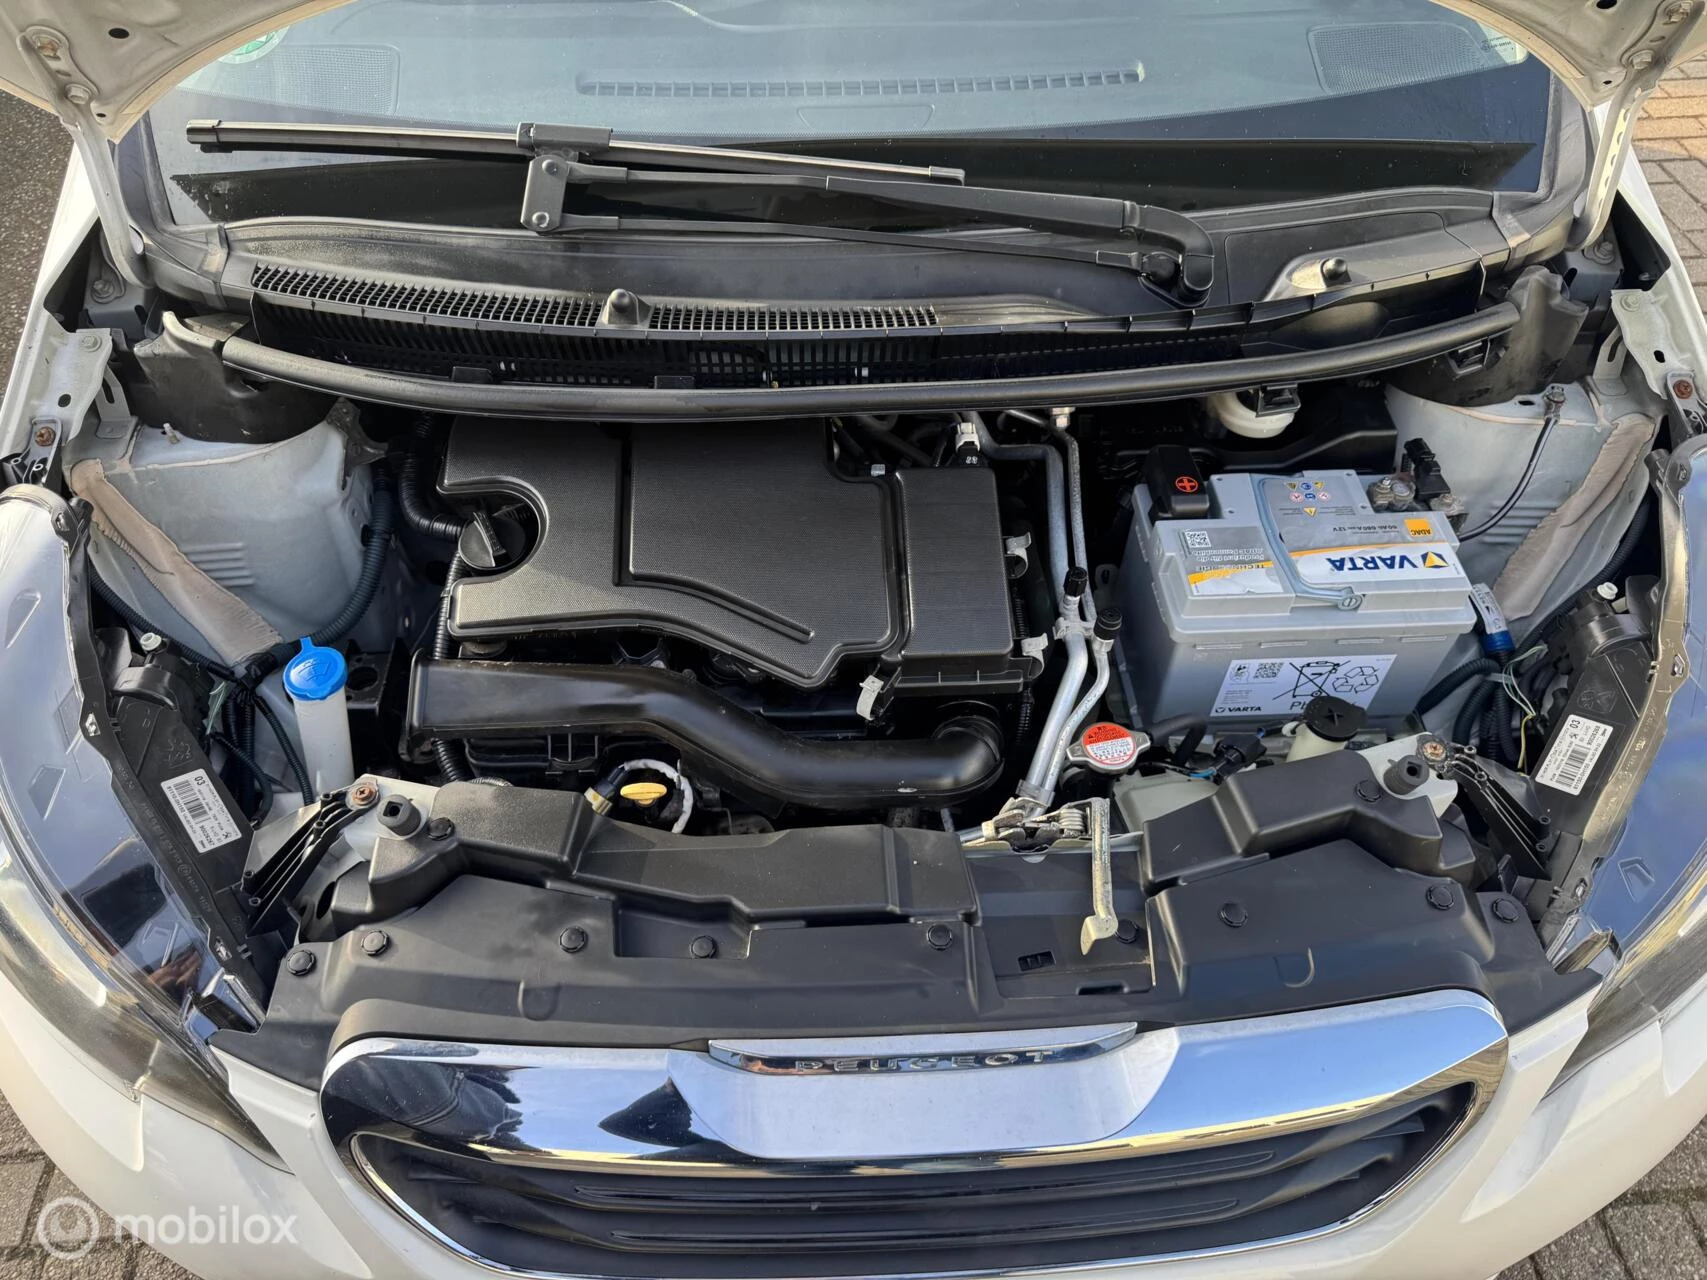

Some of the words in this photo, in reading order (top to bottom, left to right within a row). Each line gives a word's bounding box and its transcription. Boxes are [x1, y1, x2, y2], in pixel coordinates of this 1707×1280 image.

[1409, 527, 1432, 536] ADAC
[1326, 554, 1418, 571] VARTA
[1569, 719, 1581, 729] 03
[194, 775, 206, 786] 03
[795, 1050, 1057, 1073] PEUGEOT
